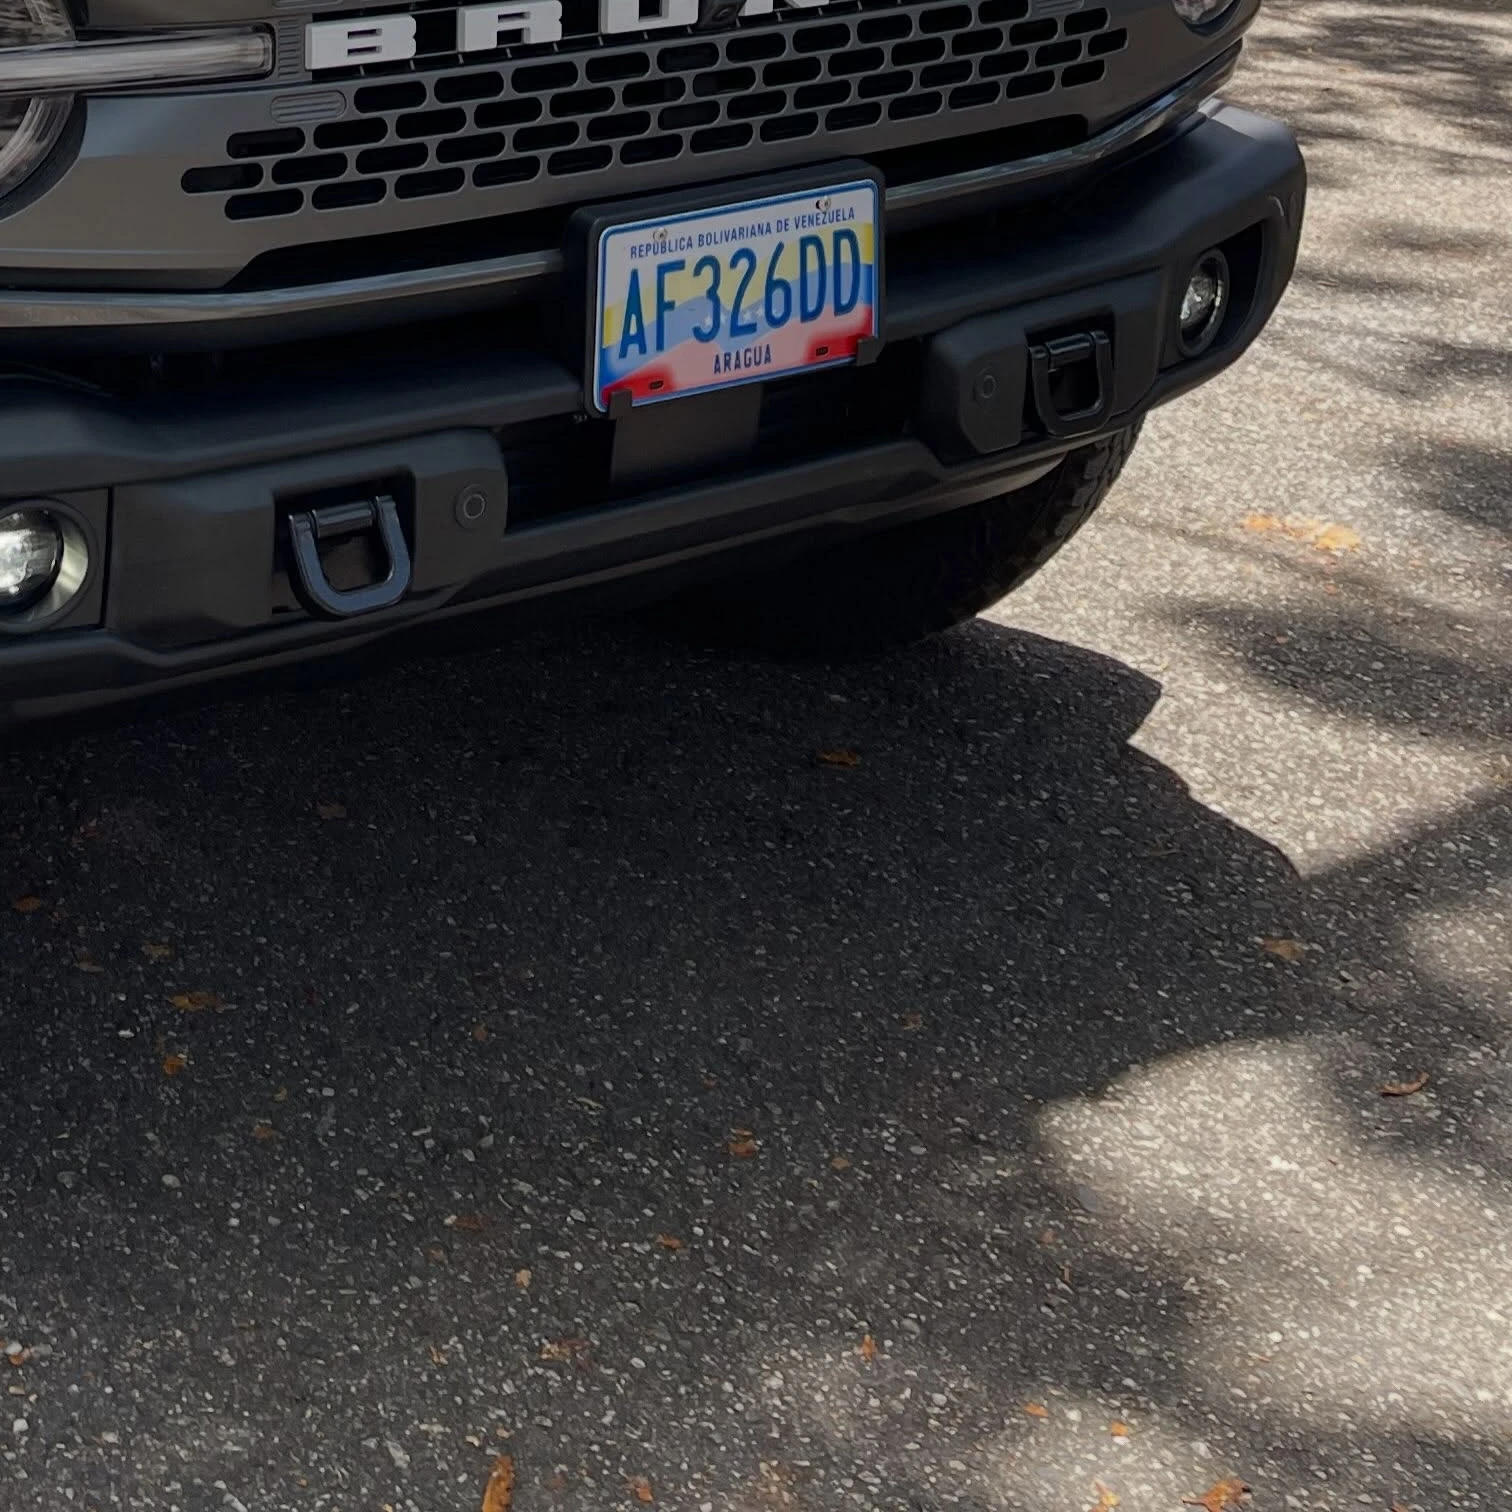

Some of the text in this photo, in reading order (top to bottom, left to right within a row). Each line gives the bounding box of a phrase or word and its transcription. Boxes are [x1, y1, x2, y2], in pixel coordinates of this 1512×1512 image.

[698, 222, 772, 246] BOLIVARIANA
[776, 218, 790, 233] DE
[793, 207, 856, 230] VENEZUELA
[618, 229, 861, 360] AF326DD
[713, 344, 772, 375] ARAGUA
